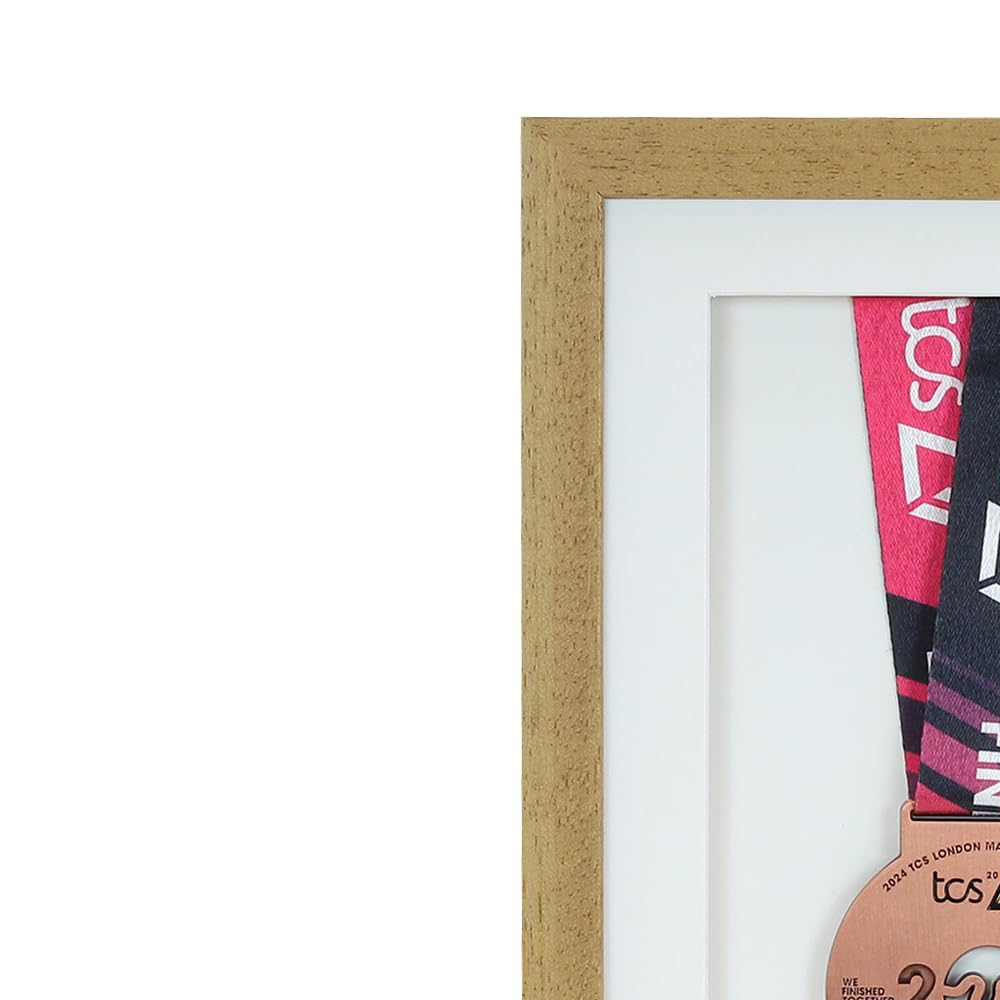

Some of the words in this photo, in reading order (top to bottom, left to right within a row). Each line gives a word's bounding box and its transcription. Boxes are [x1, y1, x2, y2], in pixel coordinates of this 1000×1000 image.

[882, 869, 908, 893] 2024
[908, 855, 930, 872] TCS
[932, 842, 981, 861] LONDON
[932, 870, 984, 904] tcs
[986, 871, 999, 880] 20
[841, 986, 885, 996] FINISHED
[842, 977, 859, 987] WE
